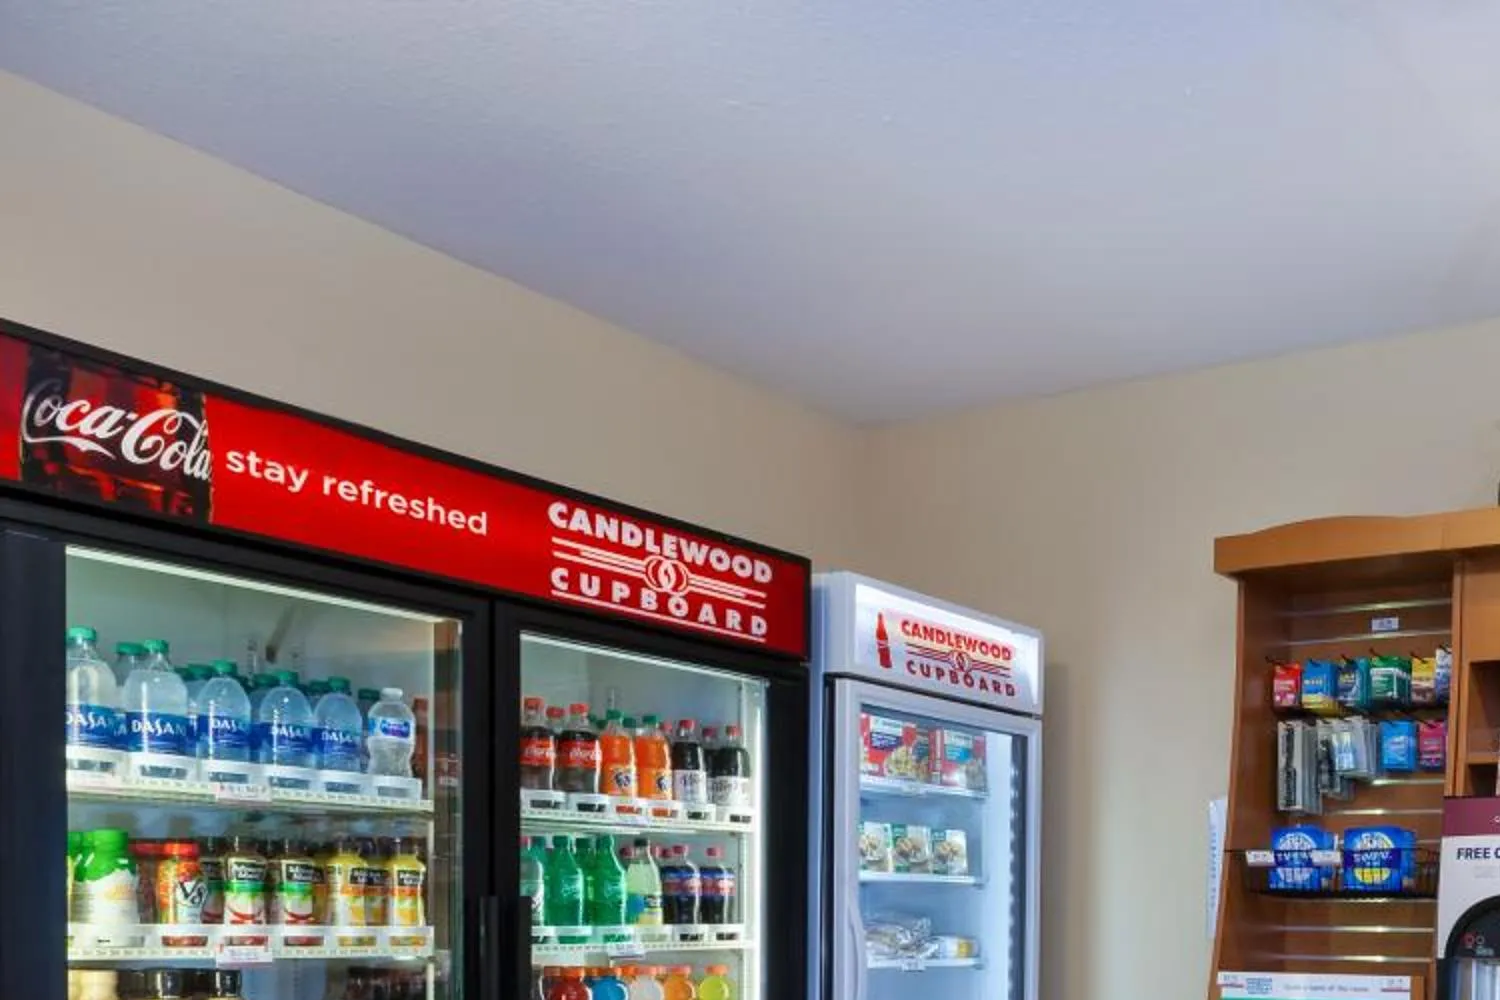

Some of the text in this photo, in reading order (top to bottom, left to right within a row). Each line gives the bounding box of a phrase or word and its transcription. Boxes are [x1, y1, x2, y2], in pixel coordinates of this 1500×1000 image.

[226, 450, 487, 536] stay refreshed
[548, 501, 773, 584] CANDLEWOOD
[551, 567, 768, 637] CUPBOARD
[900, 619, 1013, 662] CANDLEWOOD
[906, 659, 1016, 697] CUPBOARD
[1456, 847, 1491, 860] FREE
